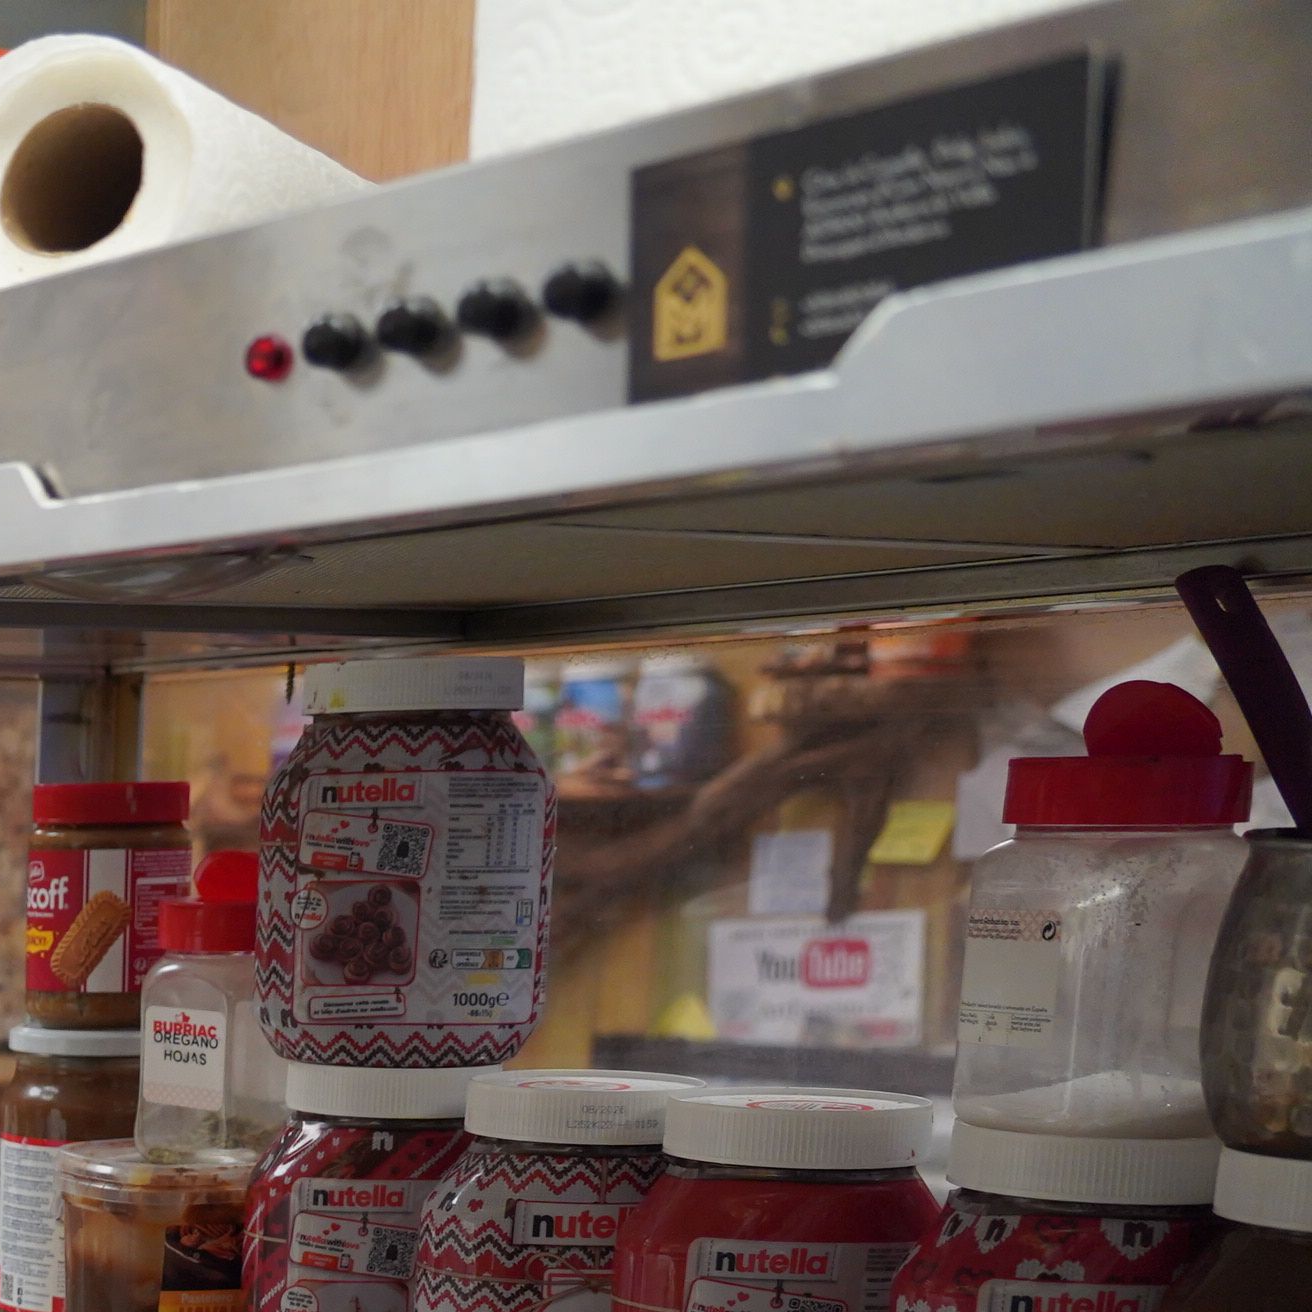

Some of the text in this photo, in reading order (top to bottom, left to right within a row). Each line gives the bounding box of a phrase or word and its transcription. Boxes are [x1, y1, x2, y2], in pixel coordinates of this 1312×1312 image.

[321, 778, 416, 804] nutella
[153, 1020, 217, 1040] BURRIAC
[153, 1031, 219, 1049] OREGANO
[164, 1050, 207, 1065] HOJAS
[313, 1184, 405, 1207] nutella
[532, 1209, 616, 1239] nute
[715, 1247, 829, 1275] nutella
